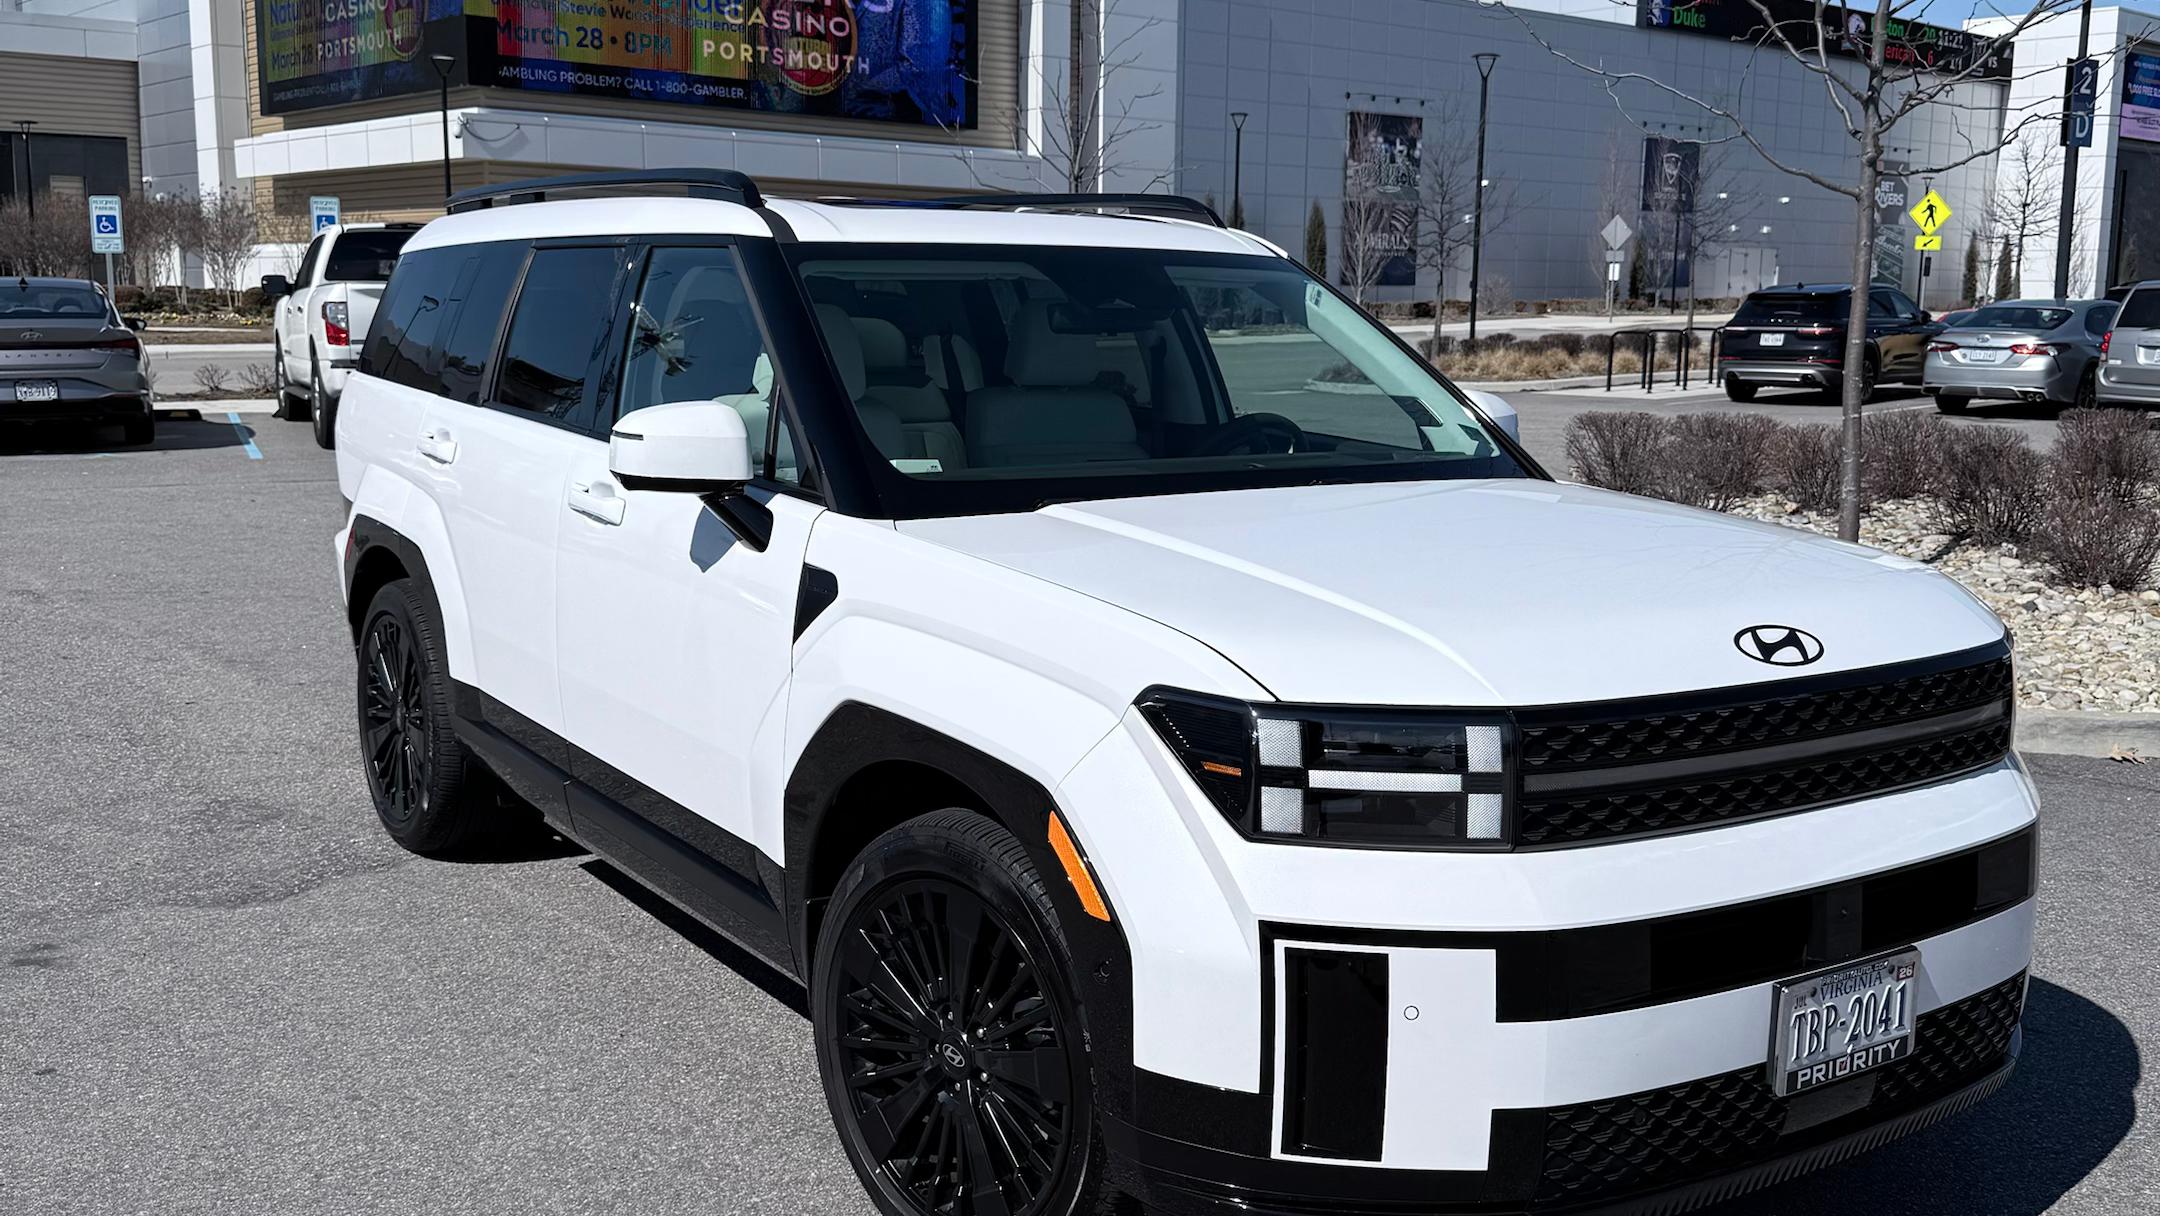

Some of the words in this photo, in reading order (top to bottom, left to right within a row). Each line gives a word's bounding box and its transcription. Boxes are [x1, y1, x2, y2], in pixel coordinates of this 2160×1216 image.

[560, 0, 607, 17] Stevie
[723, 4, 850, 37] CASINO
[1672, 7, 1707, 28] Duke
[317, 28, 402, 62] PORTSMOUTH
[497, 19, 569, 48] March
[575, 26, 604, 50] 28
[702, 39, 870, 75] PORTSMOUTH
[560, 71, 621, 88] PROBLEM?
[623, 78, 653, 91] CALL
[2080, 66, 2093, 94] 2
[2075, 111, 2090, 138] D
[1874, 187, 1905, 209] RIVERS
[1881, 181, 1895, 192] BET
[1899, 965, 1913, 979] 26
[1820, 972, 1884, 1001] VIRGINIA
[1797, 1039, 1900, 1089] PRIORITY
